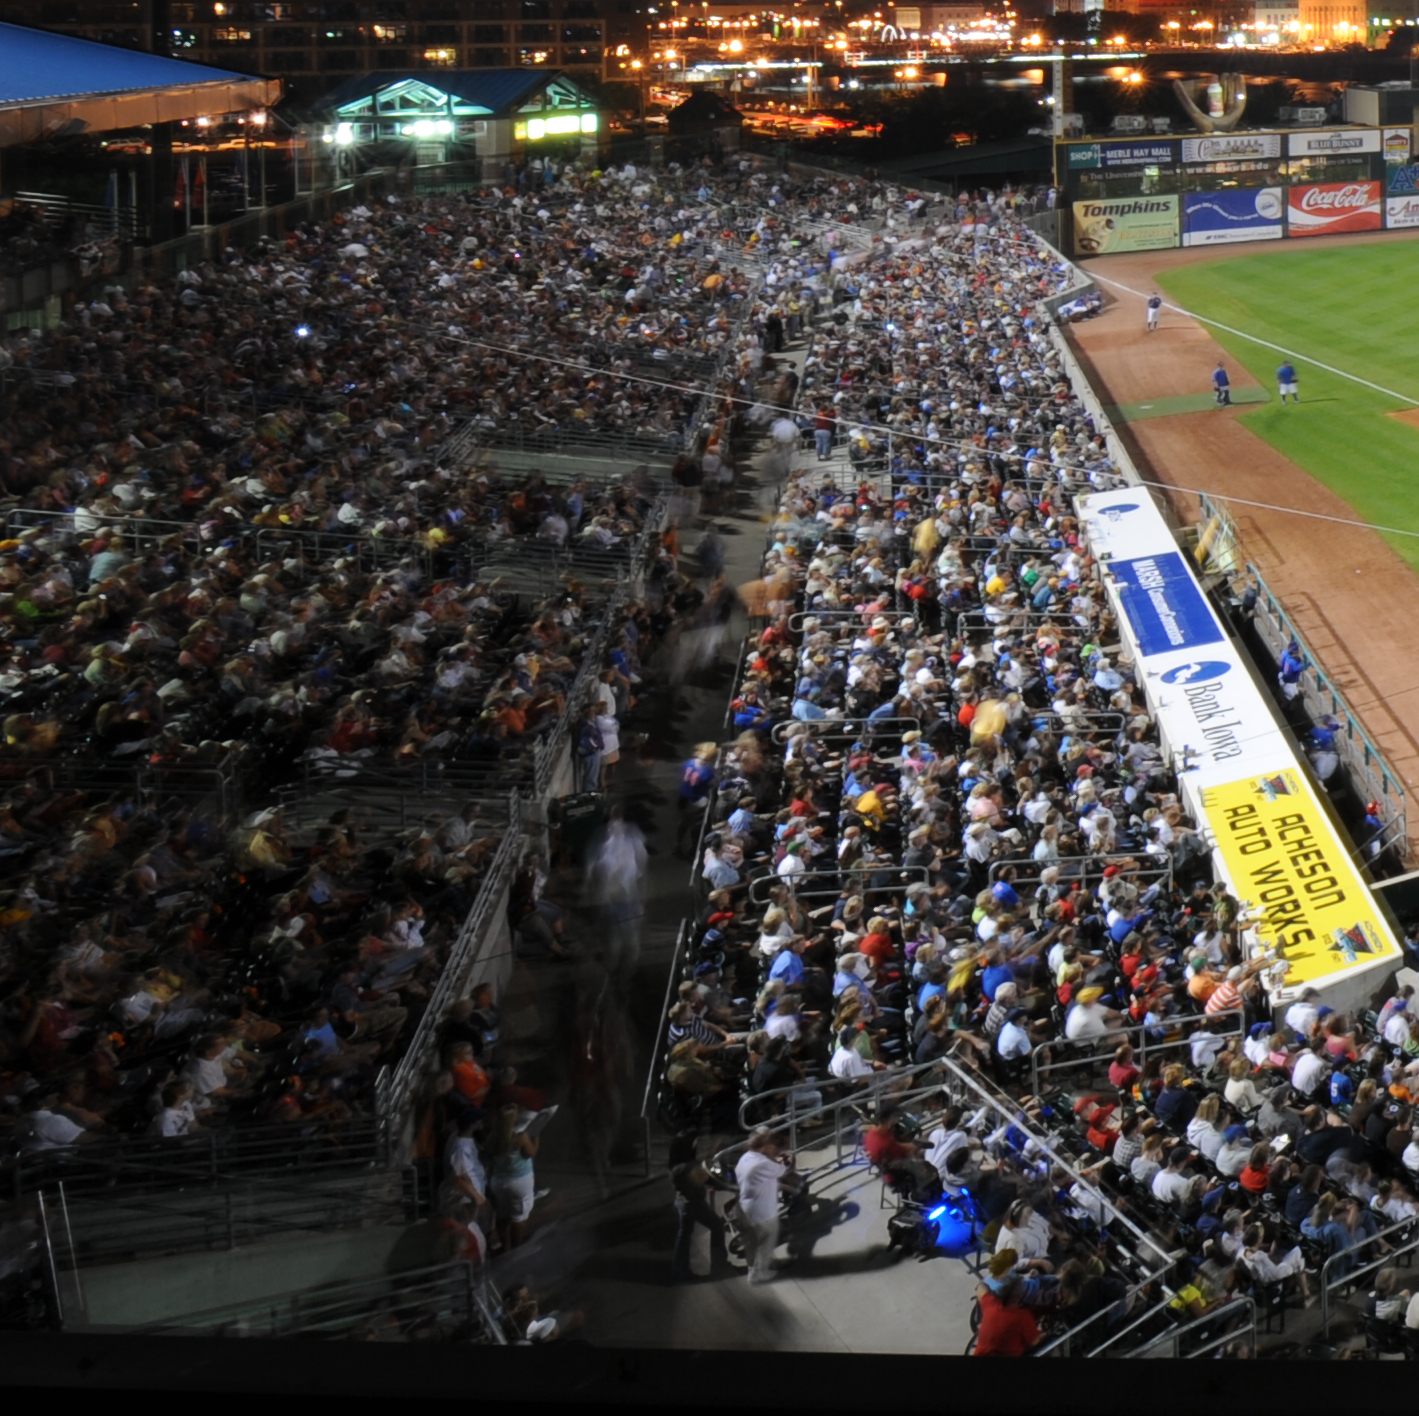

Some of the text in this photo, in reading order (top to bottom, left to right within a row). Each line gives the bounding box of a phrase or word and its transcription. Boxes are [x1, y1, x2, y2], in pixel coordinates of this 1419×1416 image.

[1070, 151, 1093, 161] SHOP
[1106, 147, 1172, 158] MERLE HAY MALL
[1310, 139, 1361, 148] BLUE BUNNY
[1082, 200, 1171, 218] Tompkins
[1301, 184, 1372, 210] Coca-Cola
[1131, 559, 1166, 590] MARSH
[1183, 681, 1243, 762] Bank Iowa
[1271, 813, 1347, 910] ACHESON
[1223, 803, 1316, 948] AUTO WORKS
